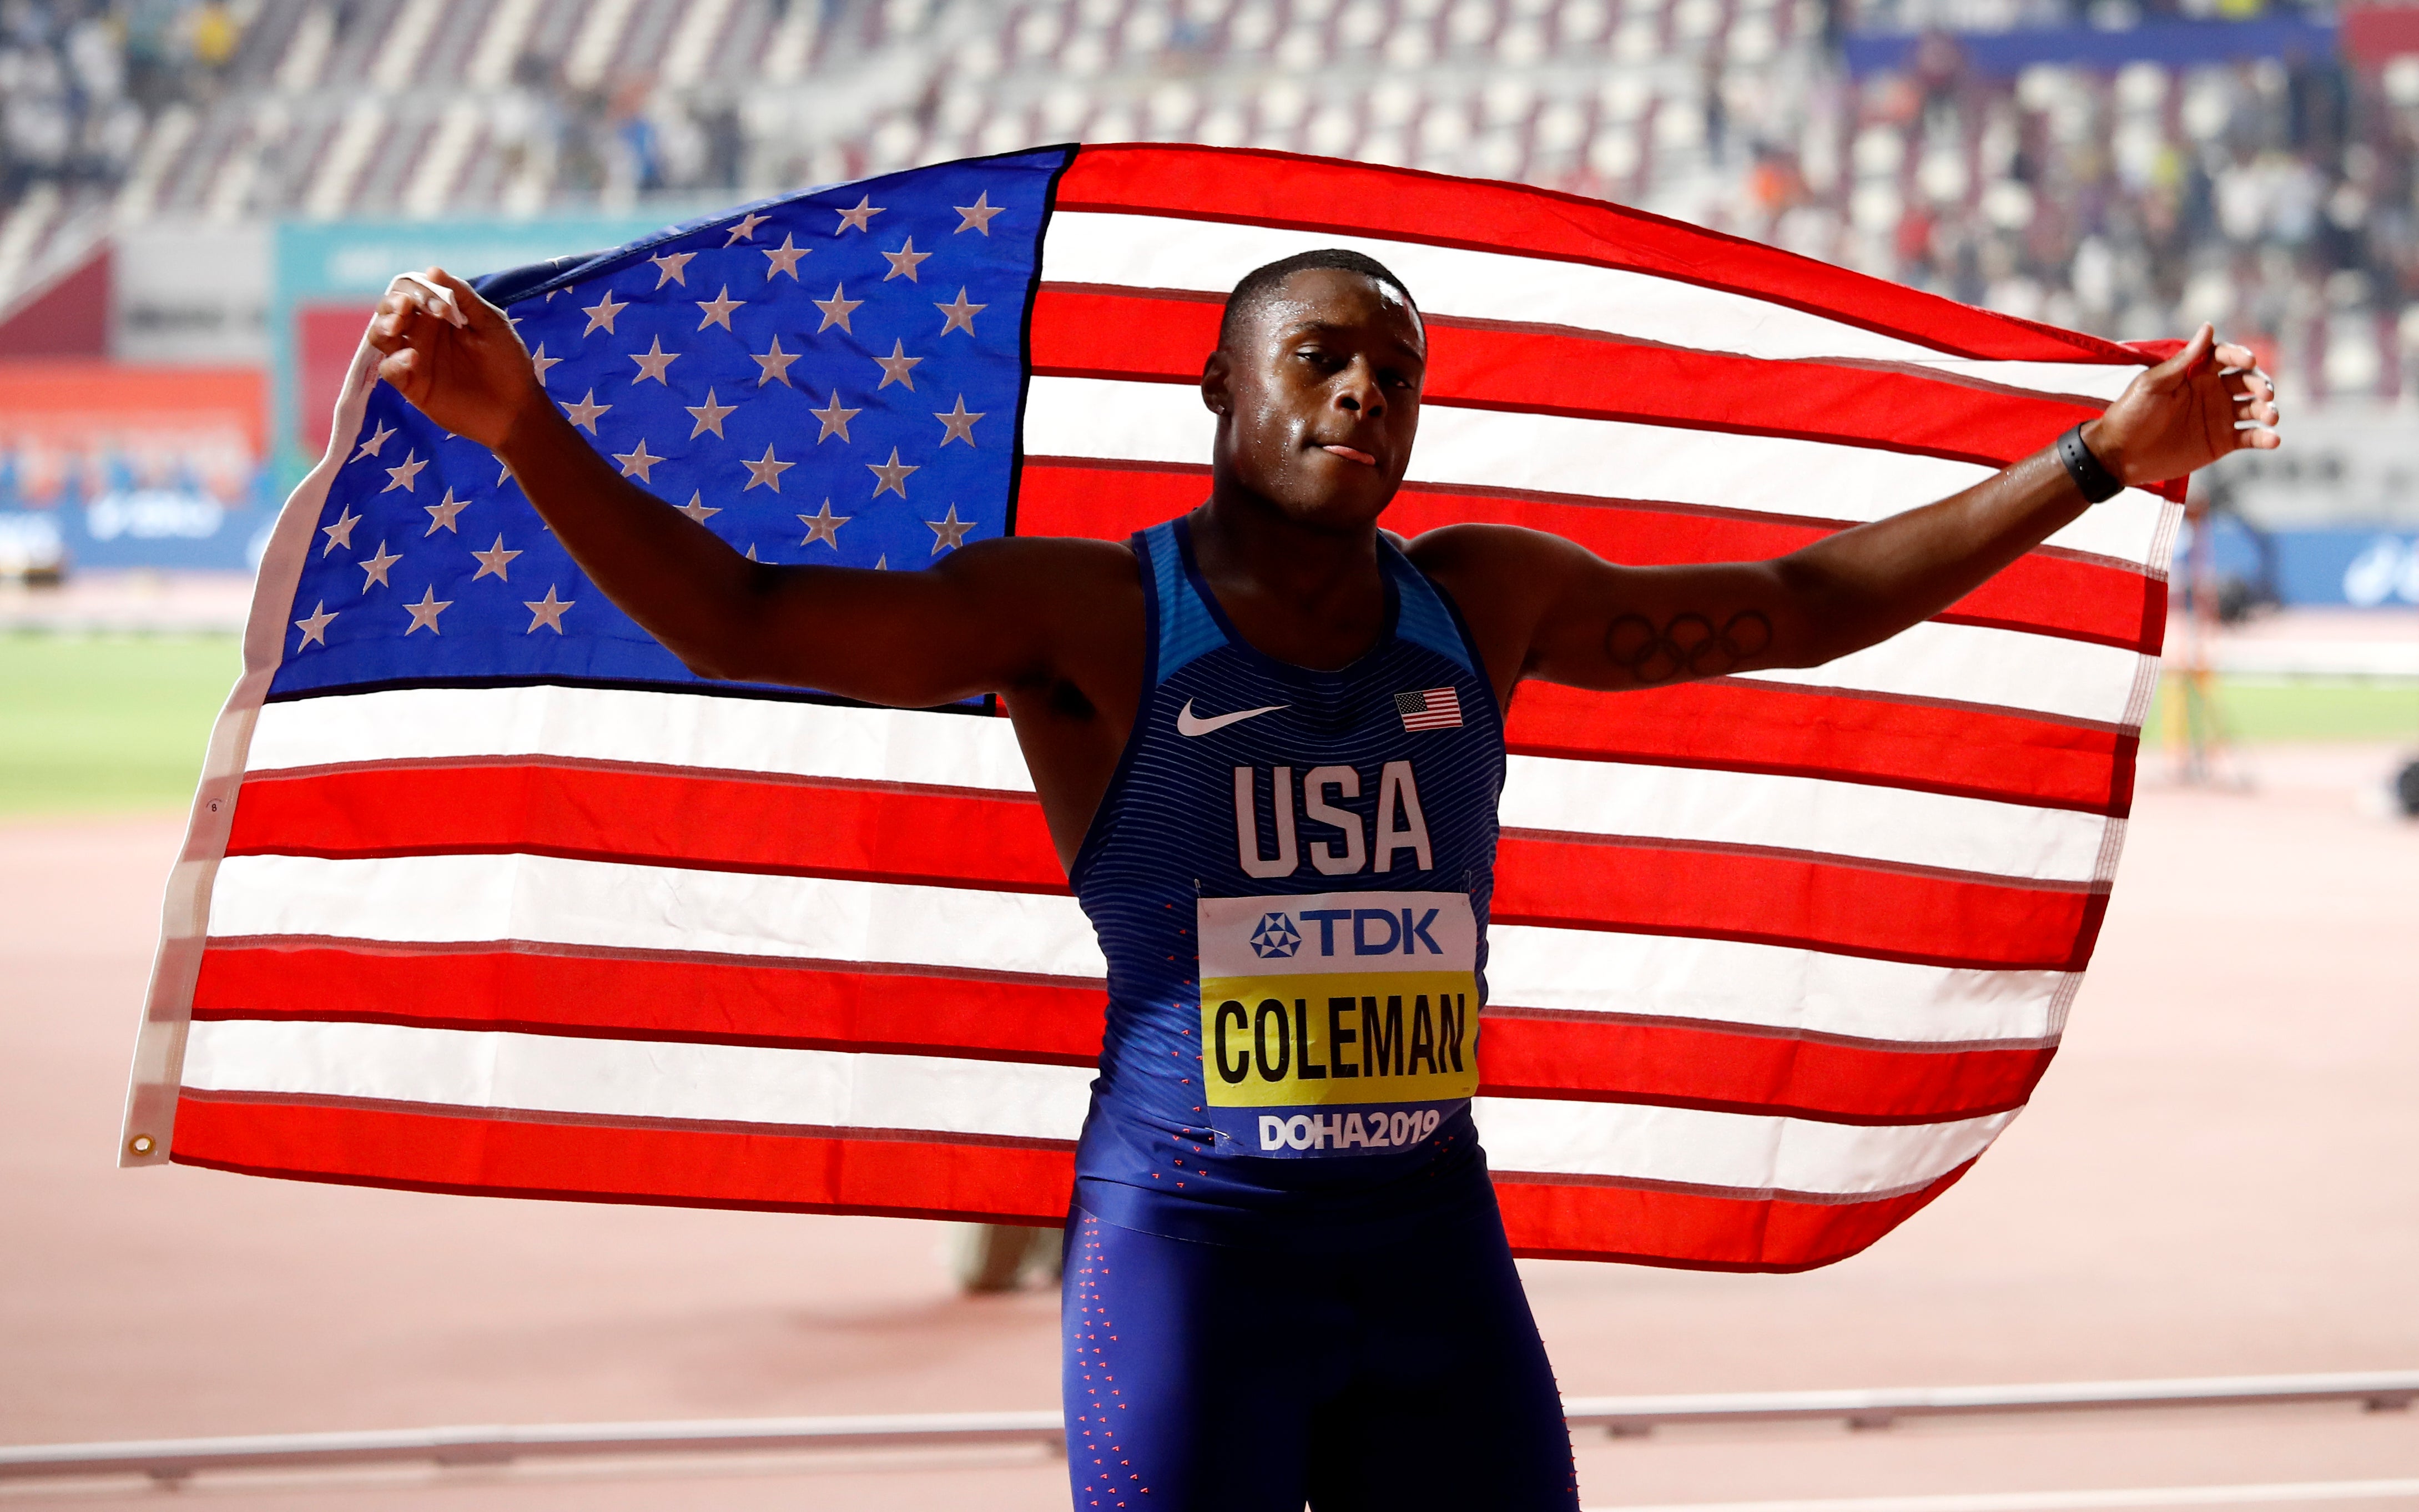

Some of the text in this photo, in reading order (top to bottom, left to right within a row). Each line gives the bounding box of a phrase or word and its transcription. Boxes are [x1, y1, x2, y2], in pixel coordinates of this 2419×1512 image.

[1234, 760, 1433, 878] USA
[1299, 908, 1443, 956] TDK
[1214, 993, 1465, 1083] COLEMAN
[1258, 1109, 1440, 1151] DOHA2019
